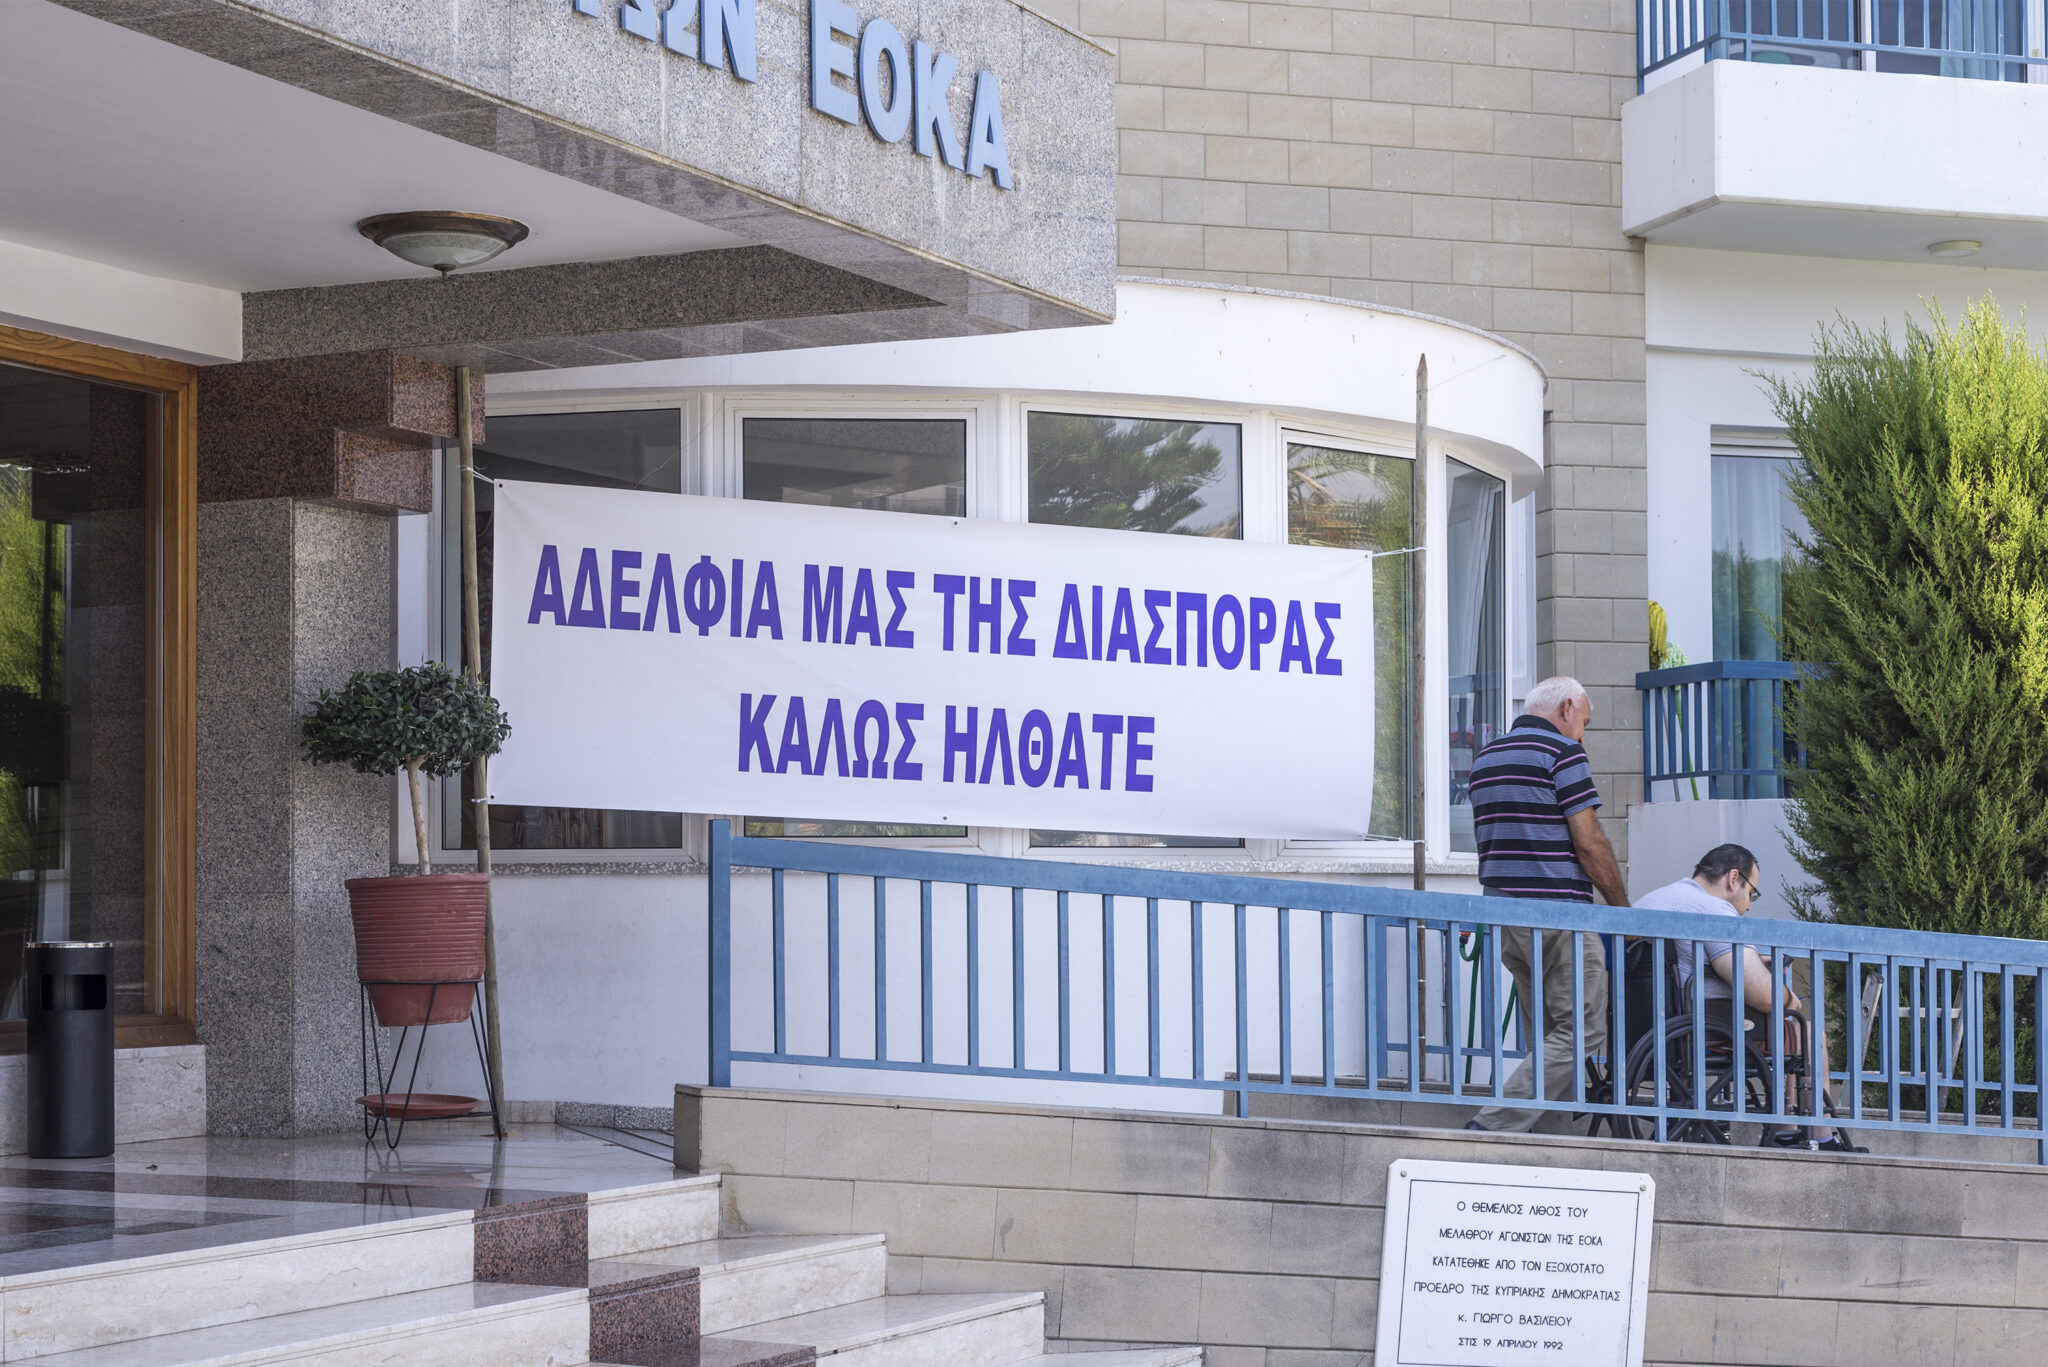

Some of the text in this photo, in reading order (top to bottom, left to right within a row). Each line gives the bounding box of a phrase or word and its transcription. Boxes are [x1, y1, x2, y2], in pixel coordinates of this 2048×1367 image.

[811, 0, 1012, 190] ΕΟΚΑ
[528, 545, 1342, 675] ΑΔΕΛΦΙΑ ΜΑΣ ΤΗΣ ΔΙΑΣΠΟΡΑΣ
[739, 693, 1154, 792] ΚΑΛΩΣ ΗΛΘΑΤΕ
[1457, 1201, 1588, 1217] Ο ΘΕΜΕΛΙΟΣ ΛΙΘΟΣ ΤΟΥ
[1440, 1228, 1602, 1246] ΜΕΛΑΘΡΟΥ ΑΓΩΝΙΣΤΩΝ ΤΗΣ ΕΟΚΑ
[1433, 1256, 1604, 1274] ΚΑΤΑΤΕΘΗΚΕ ΑΠΟ ΤΟΝ ΕΞΟΧΟΤΑΤΟ
[1414, 1282, 1620, 1301] ΠΡΟΕΔΡΟ ΤΗΣ ΚΥΠΡΙΑΚΗΣ ΔΗΜΟΚΡΑΤΙΑΣ
[1474, 1313, 1513, 1324] ΓΙΩΡΓΟ
[1519, 1315, 1572, 1326] ΒΑΣΙΛΕΙΟΥ
[1458, 1338, 1477, 1346] ΣΤΙΣ
[1497, 1339, 1538, 1348] ΑΠΡΙΛΙΟΥ
[1544, 1341, 1563, 1350] 1992
